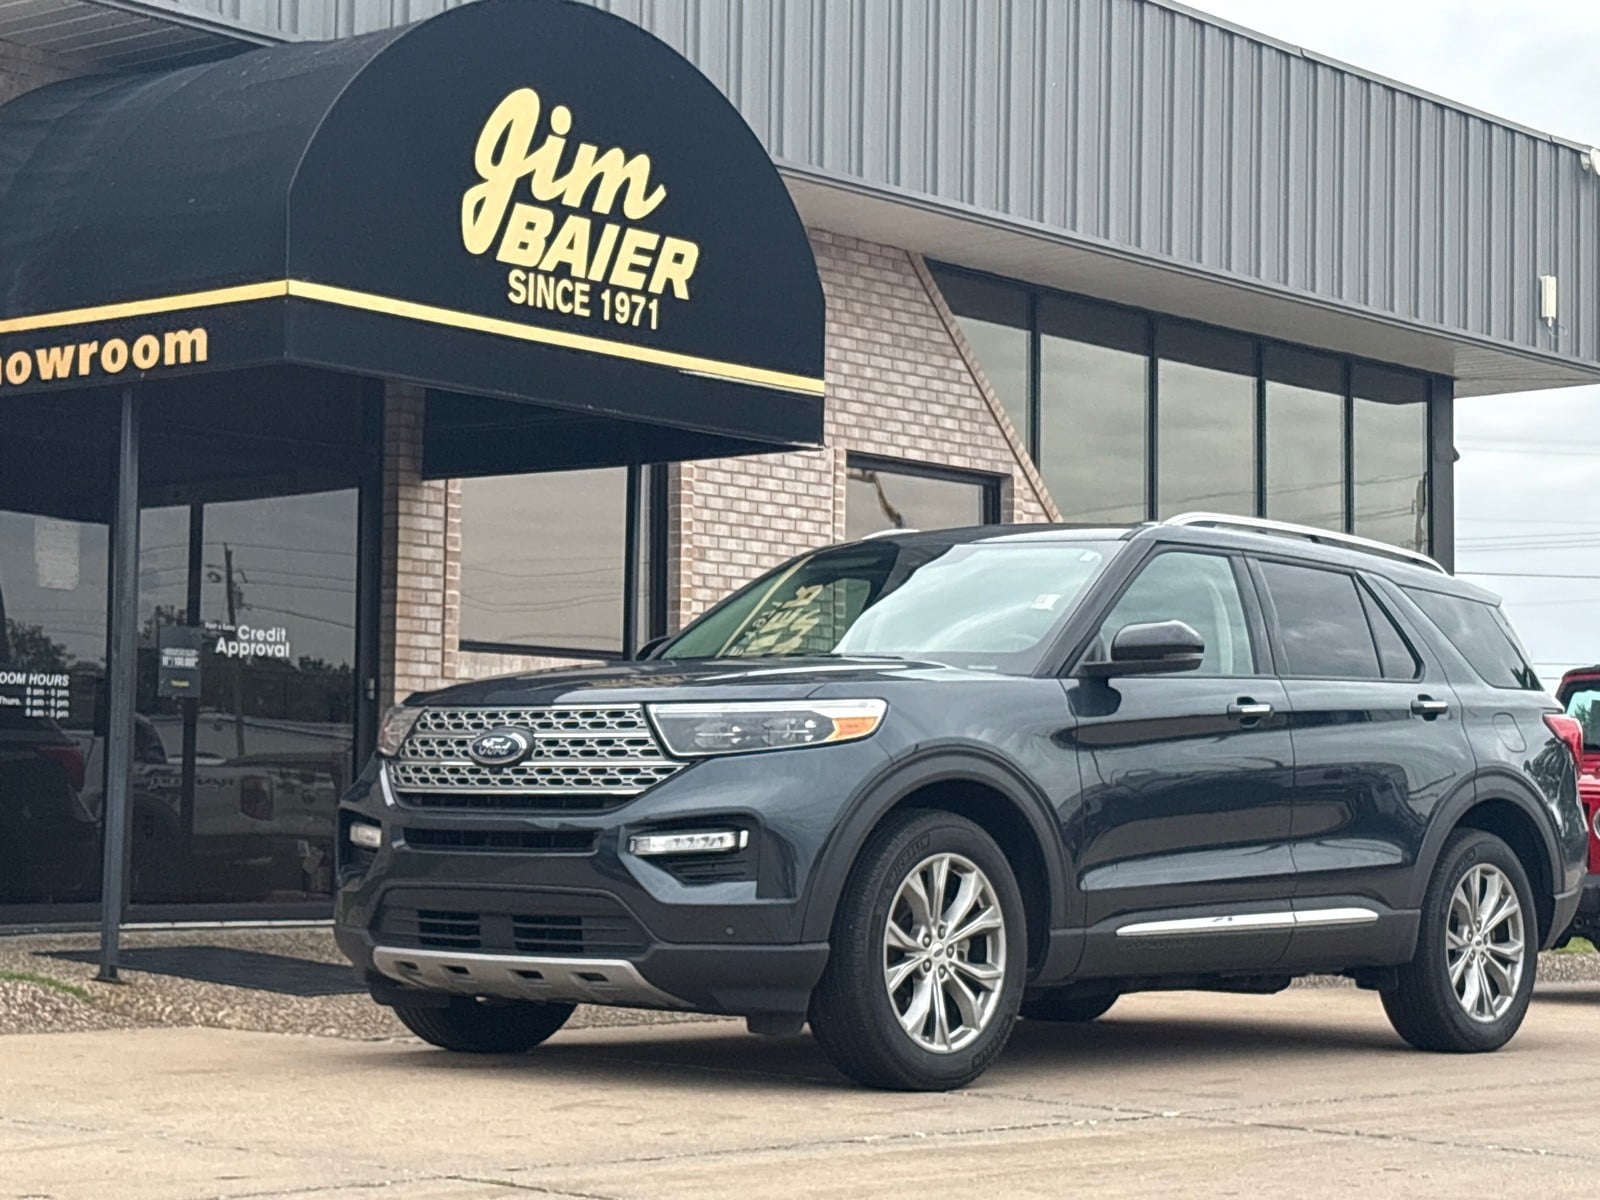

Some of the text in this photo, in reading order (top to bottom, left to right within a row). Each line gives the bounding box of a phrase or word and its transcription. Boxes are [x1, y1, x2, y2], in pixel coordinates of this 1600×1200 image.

[461, 87, 667, 255] Jim
[495, 202, 699, 301] BAIER
[507, 268, 659, 330] SINCE 1971
[0, 327, 208, 386] owroom
[215, 636, 290, 659] Approval
[237, 624, 287, 642] Credit
[29, 672, 70, 687] HOURS
